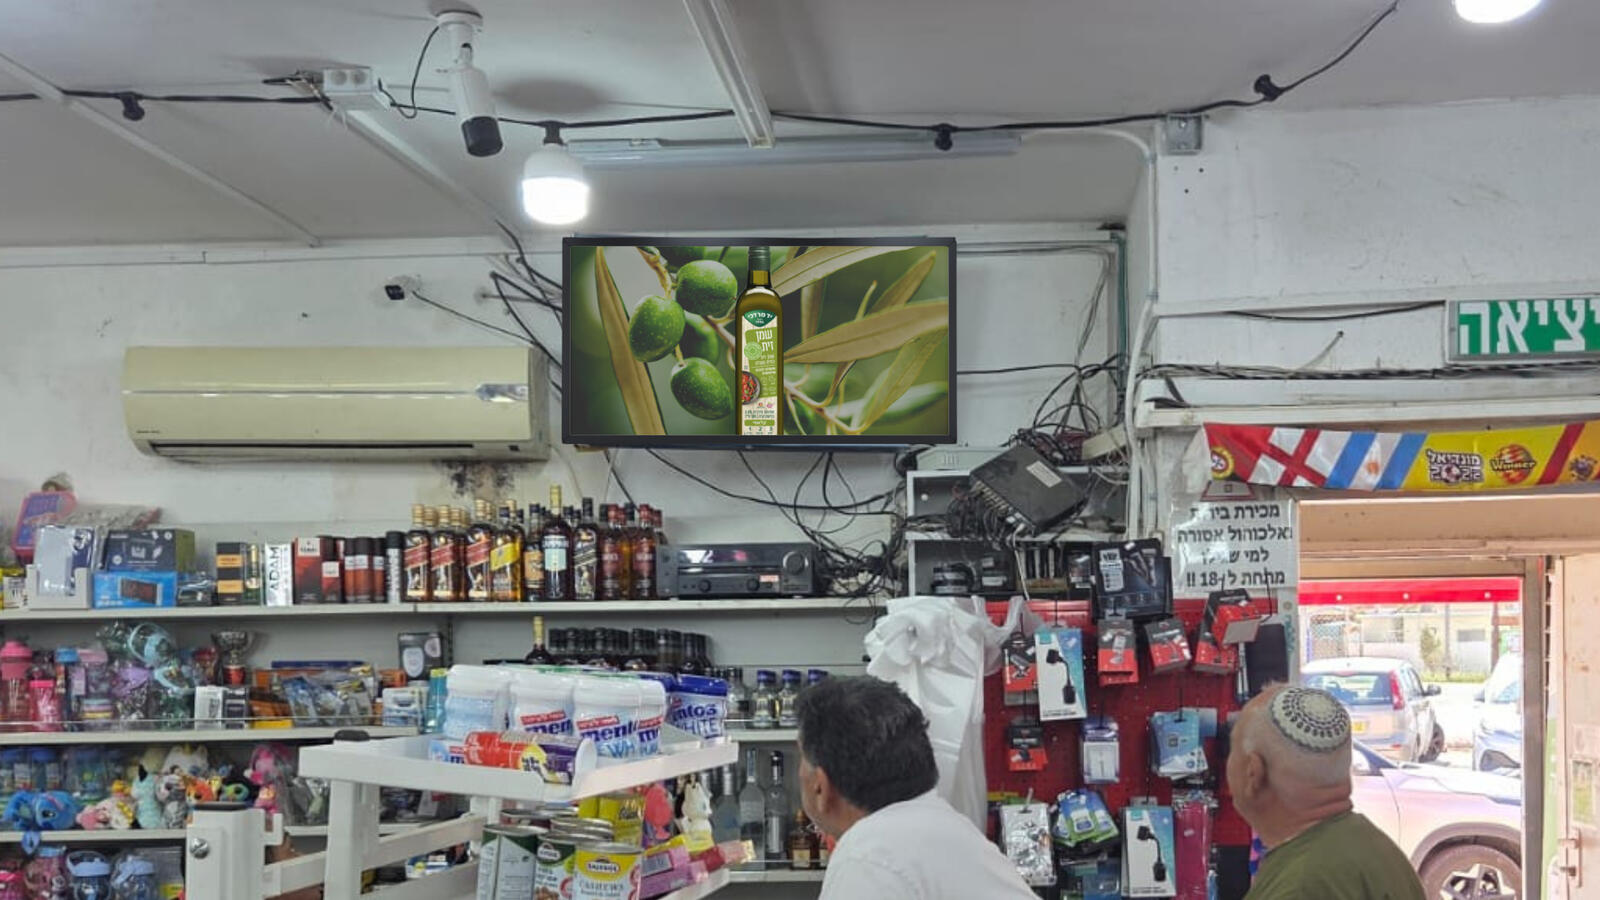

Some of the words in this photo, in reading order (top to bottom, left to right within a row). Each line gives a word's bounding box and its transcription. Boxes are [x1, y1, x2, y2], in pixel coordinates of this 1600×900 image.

[1459, 299, 1600, 355] יציאה
[755, 329, 773, 342] שמן
[761, 341, 774, 352] זית
[1426, 449, 1481, 465] מונדיאל
[1490, 458, 1536, 472] Winner
[1234, 504, 1280, 519] מכירת
[1177, 528, 1225, 543] אסורה
[1244, 546, 1270, 563] למי
[269, 546, 280, 591] ADAM
[1240, 570, 1286, 586] מתחת
